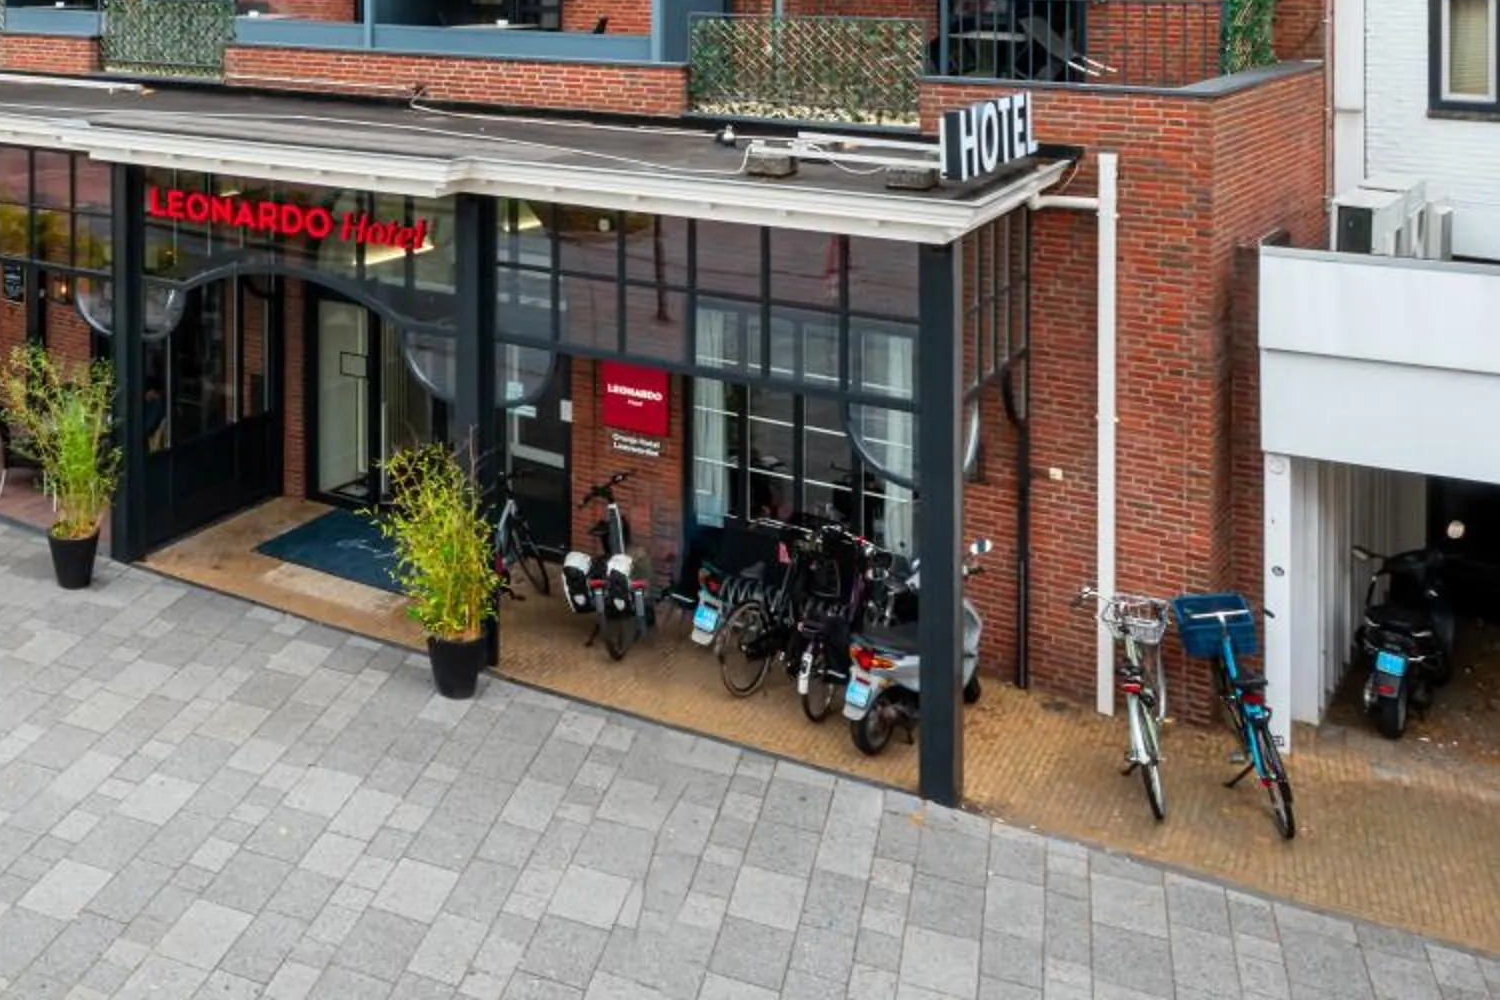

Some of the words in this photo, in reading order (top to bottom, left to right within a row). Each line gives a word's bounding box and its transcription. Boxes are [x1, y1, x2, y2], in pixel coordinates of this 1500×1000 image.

[959, 91, 1039, 182] HOTEL
[149, 185, 333, 239] LEONARDO
[340, 211, 427, 250] Hotel
[607, 383, 663, 401] LEONARDO
